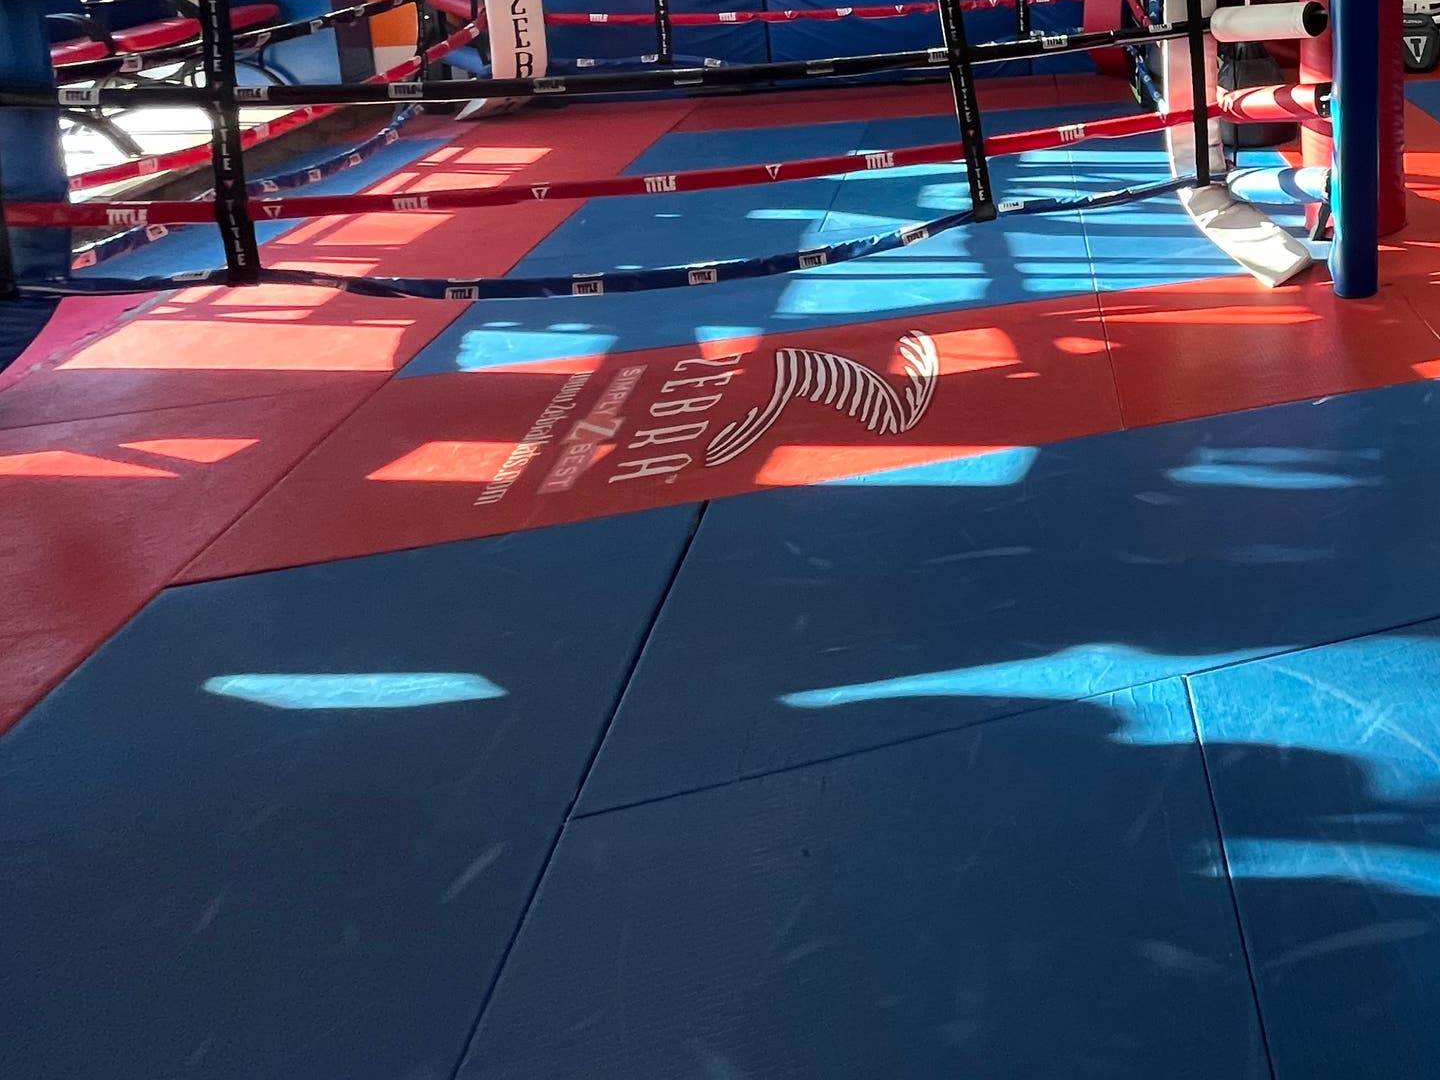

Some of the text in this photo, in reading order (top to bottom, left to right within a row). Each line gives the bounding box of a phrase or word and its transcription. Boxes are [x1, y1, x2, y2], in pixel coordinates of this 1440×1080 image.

[208, 0, 222, 73] TITLE
[865, 152, 895, 168] TITLE
[644, 175, 676, 192] TITLE
[392, 196, 429, 210] TITLE
[106, 208, 148, 225] TITLE
[225, 199, 246, 266] TITLE
[803, 254, 822, 266] TITLE
[693, 271, 713, 282] TITLE
[451, 288, 473, 299] TITLE
[576, 283, 599, 295] TITLE
[593, 367, 642, 416] SIMPLY
[547, 442, 591, 487] BEST
